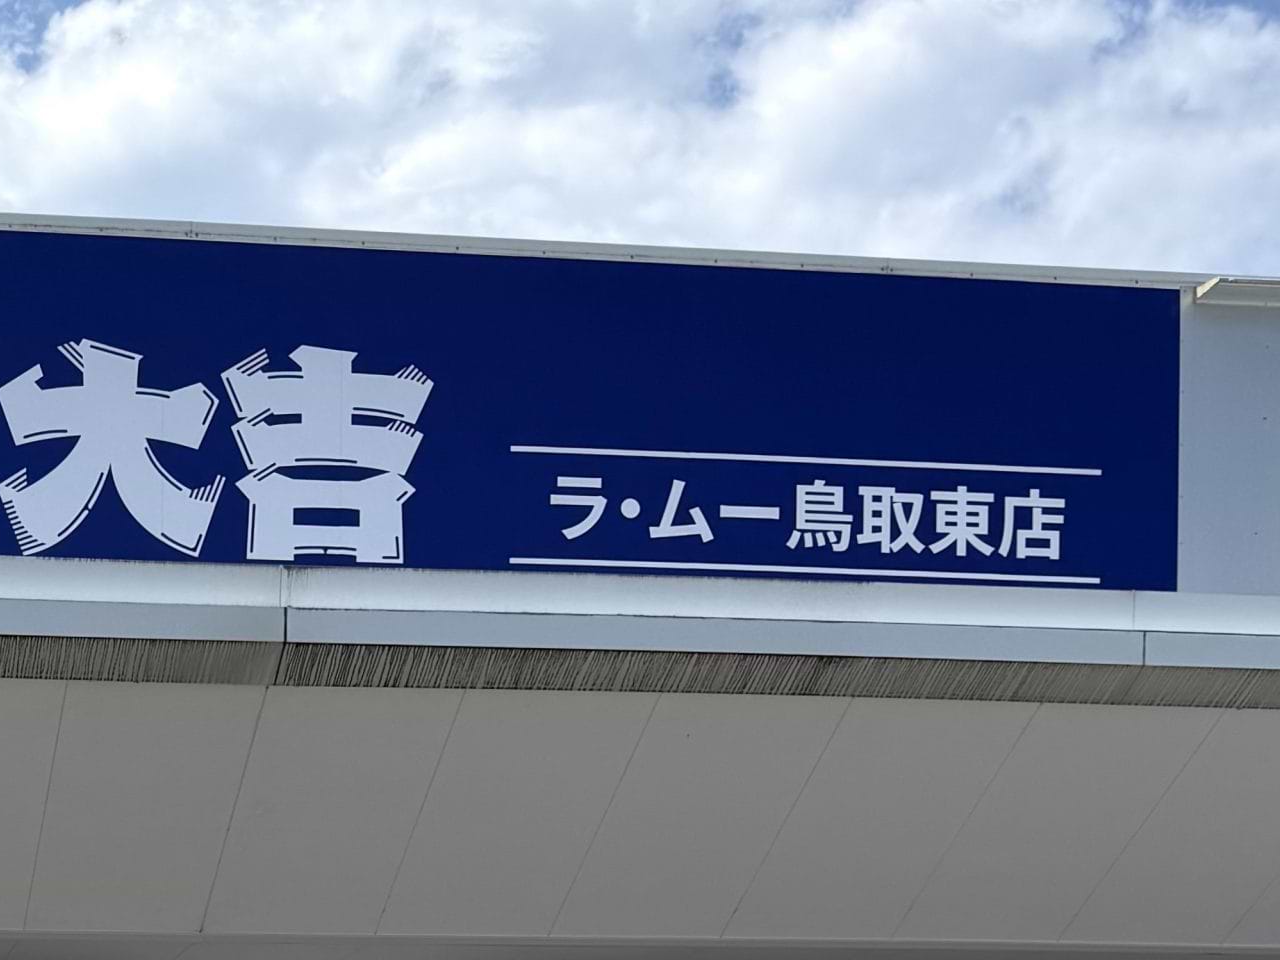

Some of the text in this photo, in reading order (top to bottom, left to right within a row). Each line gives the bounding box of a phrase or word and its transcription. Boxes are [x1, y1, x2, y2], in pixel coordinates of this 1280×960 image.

[550, 475, 1066, 560] ラ・ムー鳥取東店
